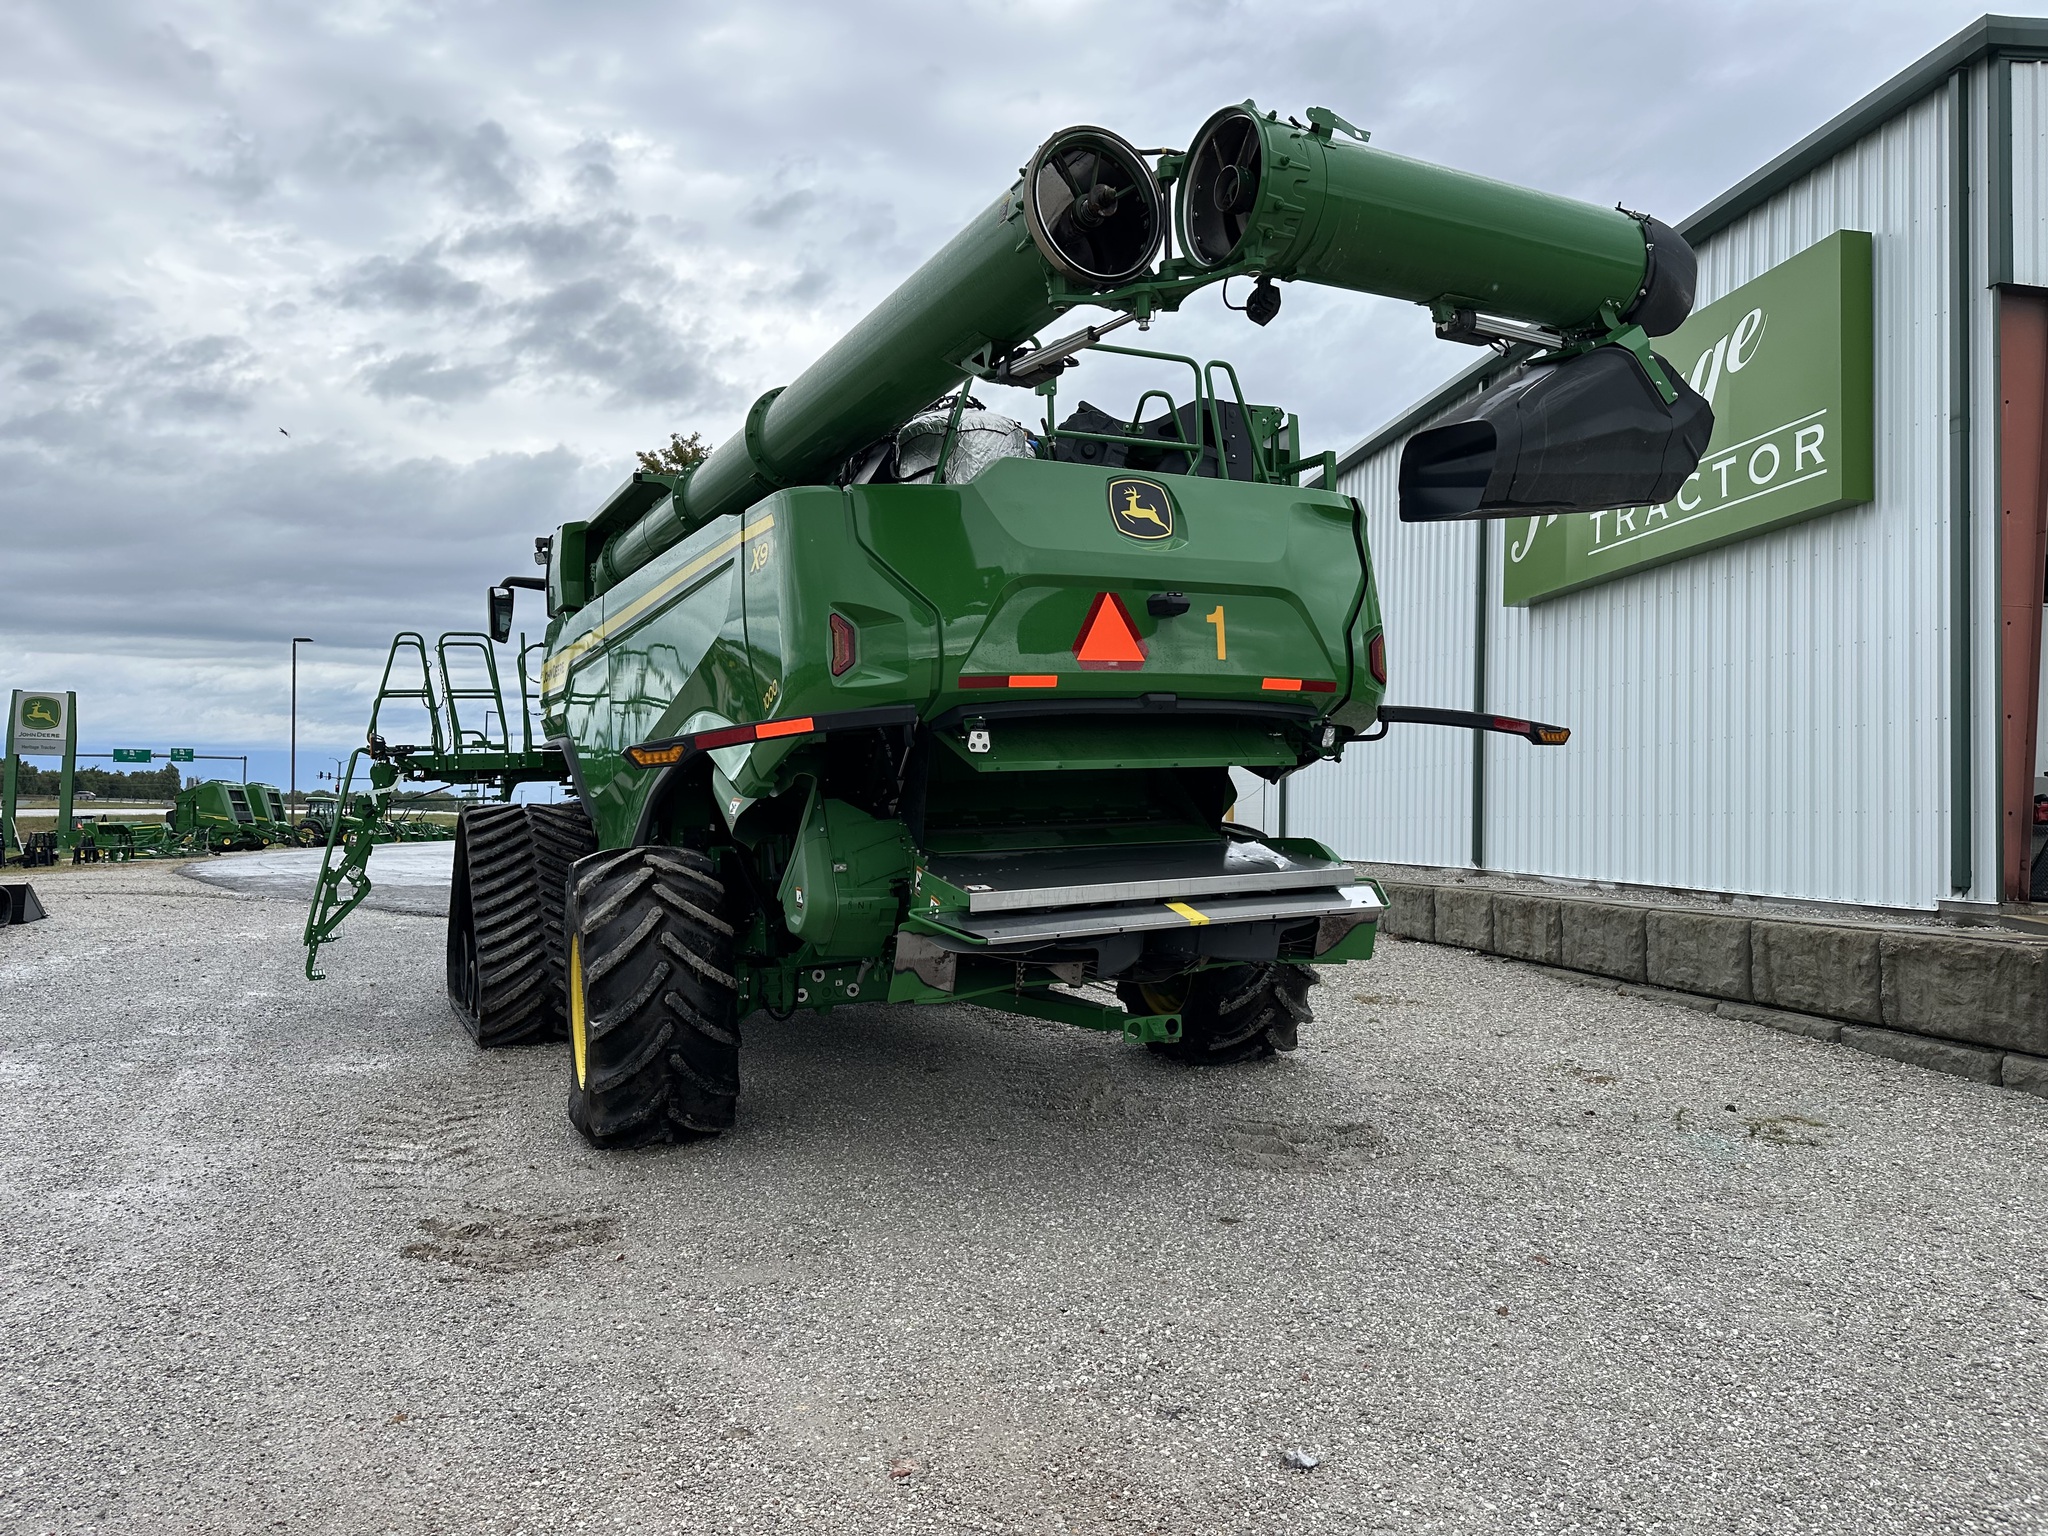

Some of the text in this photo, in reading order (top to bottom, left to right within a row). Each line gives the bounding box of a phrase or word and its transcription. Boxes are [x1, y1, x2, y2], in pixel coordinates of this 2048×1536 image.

[1589, 423, 1826, 544] TRACTOR
[750, 541, 769, 574] X9
[1206, 605, 1227, 660] 1
[763, 678, 778, 711] 1000
